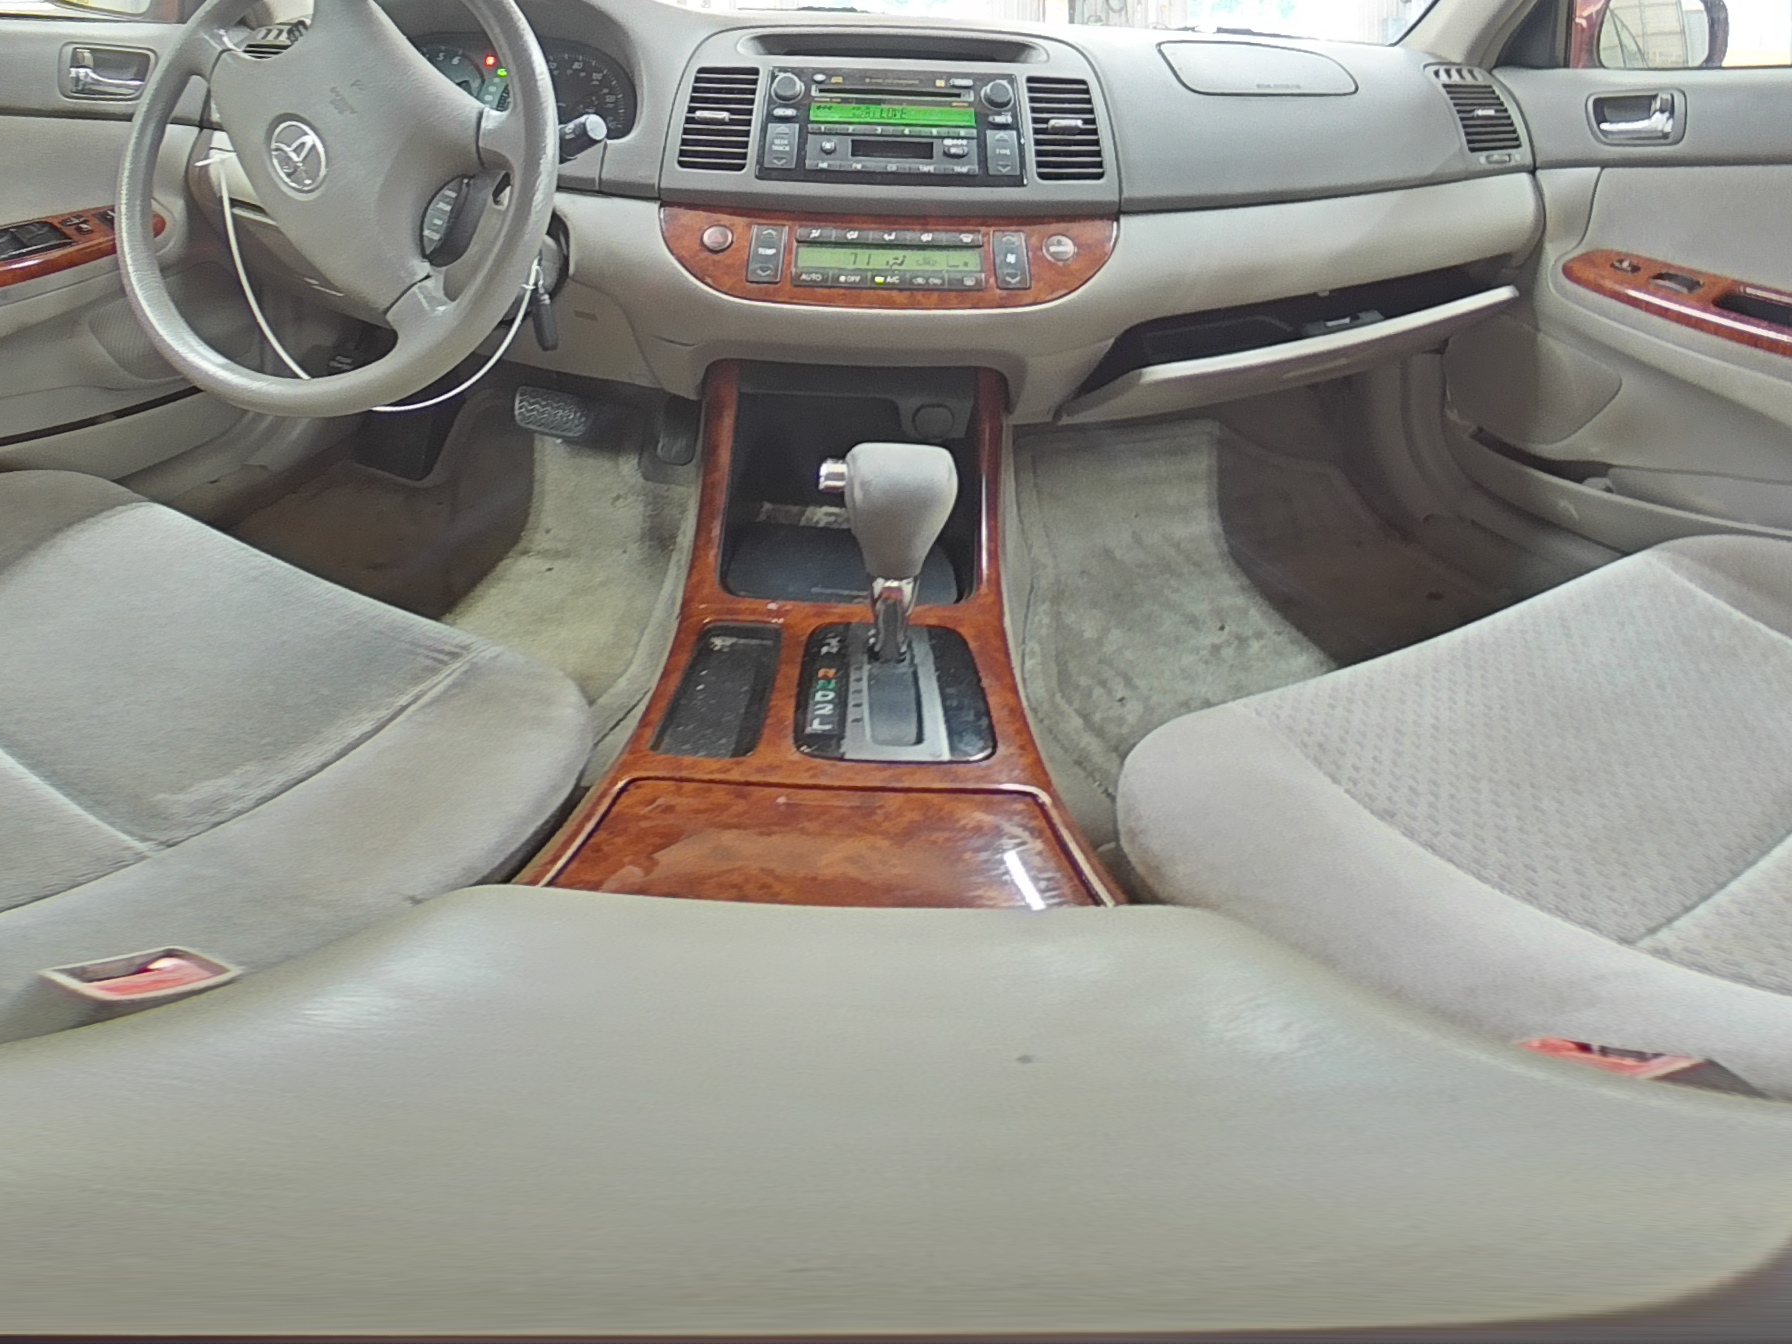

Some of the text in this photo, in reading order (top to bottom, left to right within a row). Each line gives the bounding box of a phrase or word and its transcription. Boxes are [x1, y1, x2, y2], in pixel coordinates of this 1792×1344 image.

[758, 247, 777, 256] TEMP
[800, 273, 822, 282] AUTO
[814, 690, 836, 702] D
[811, 717, 833, 730] L
